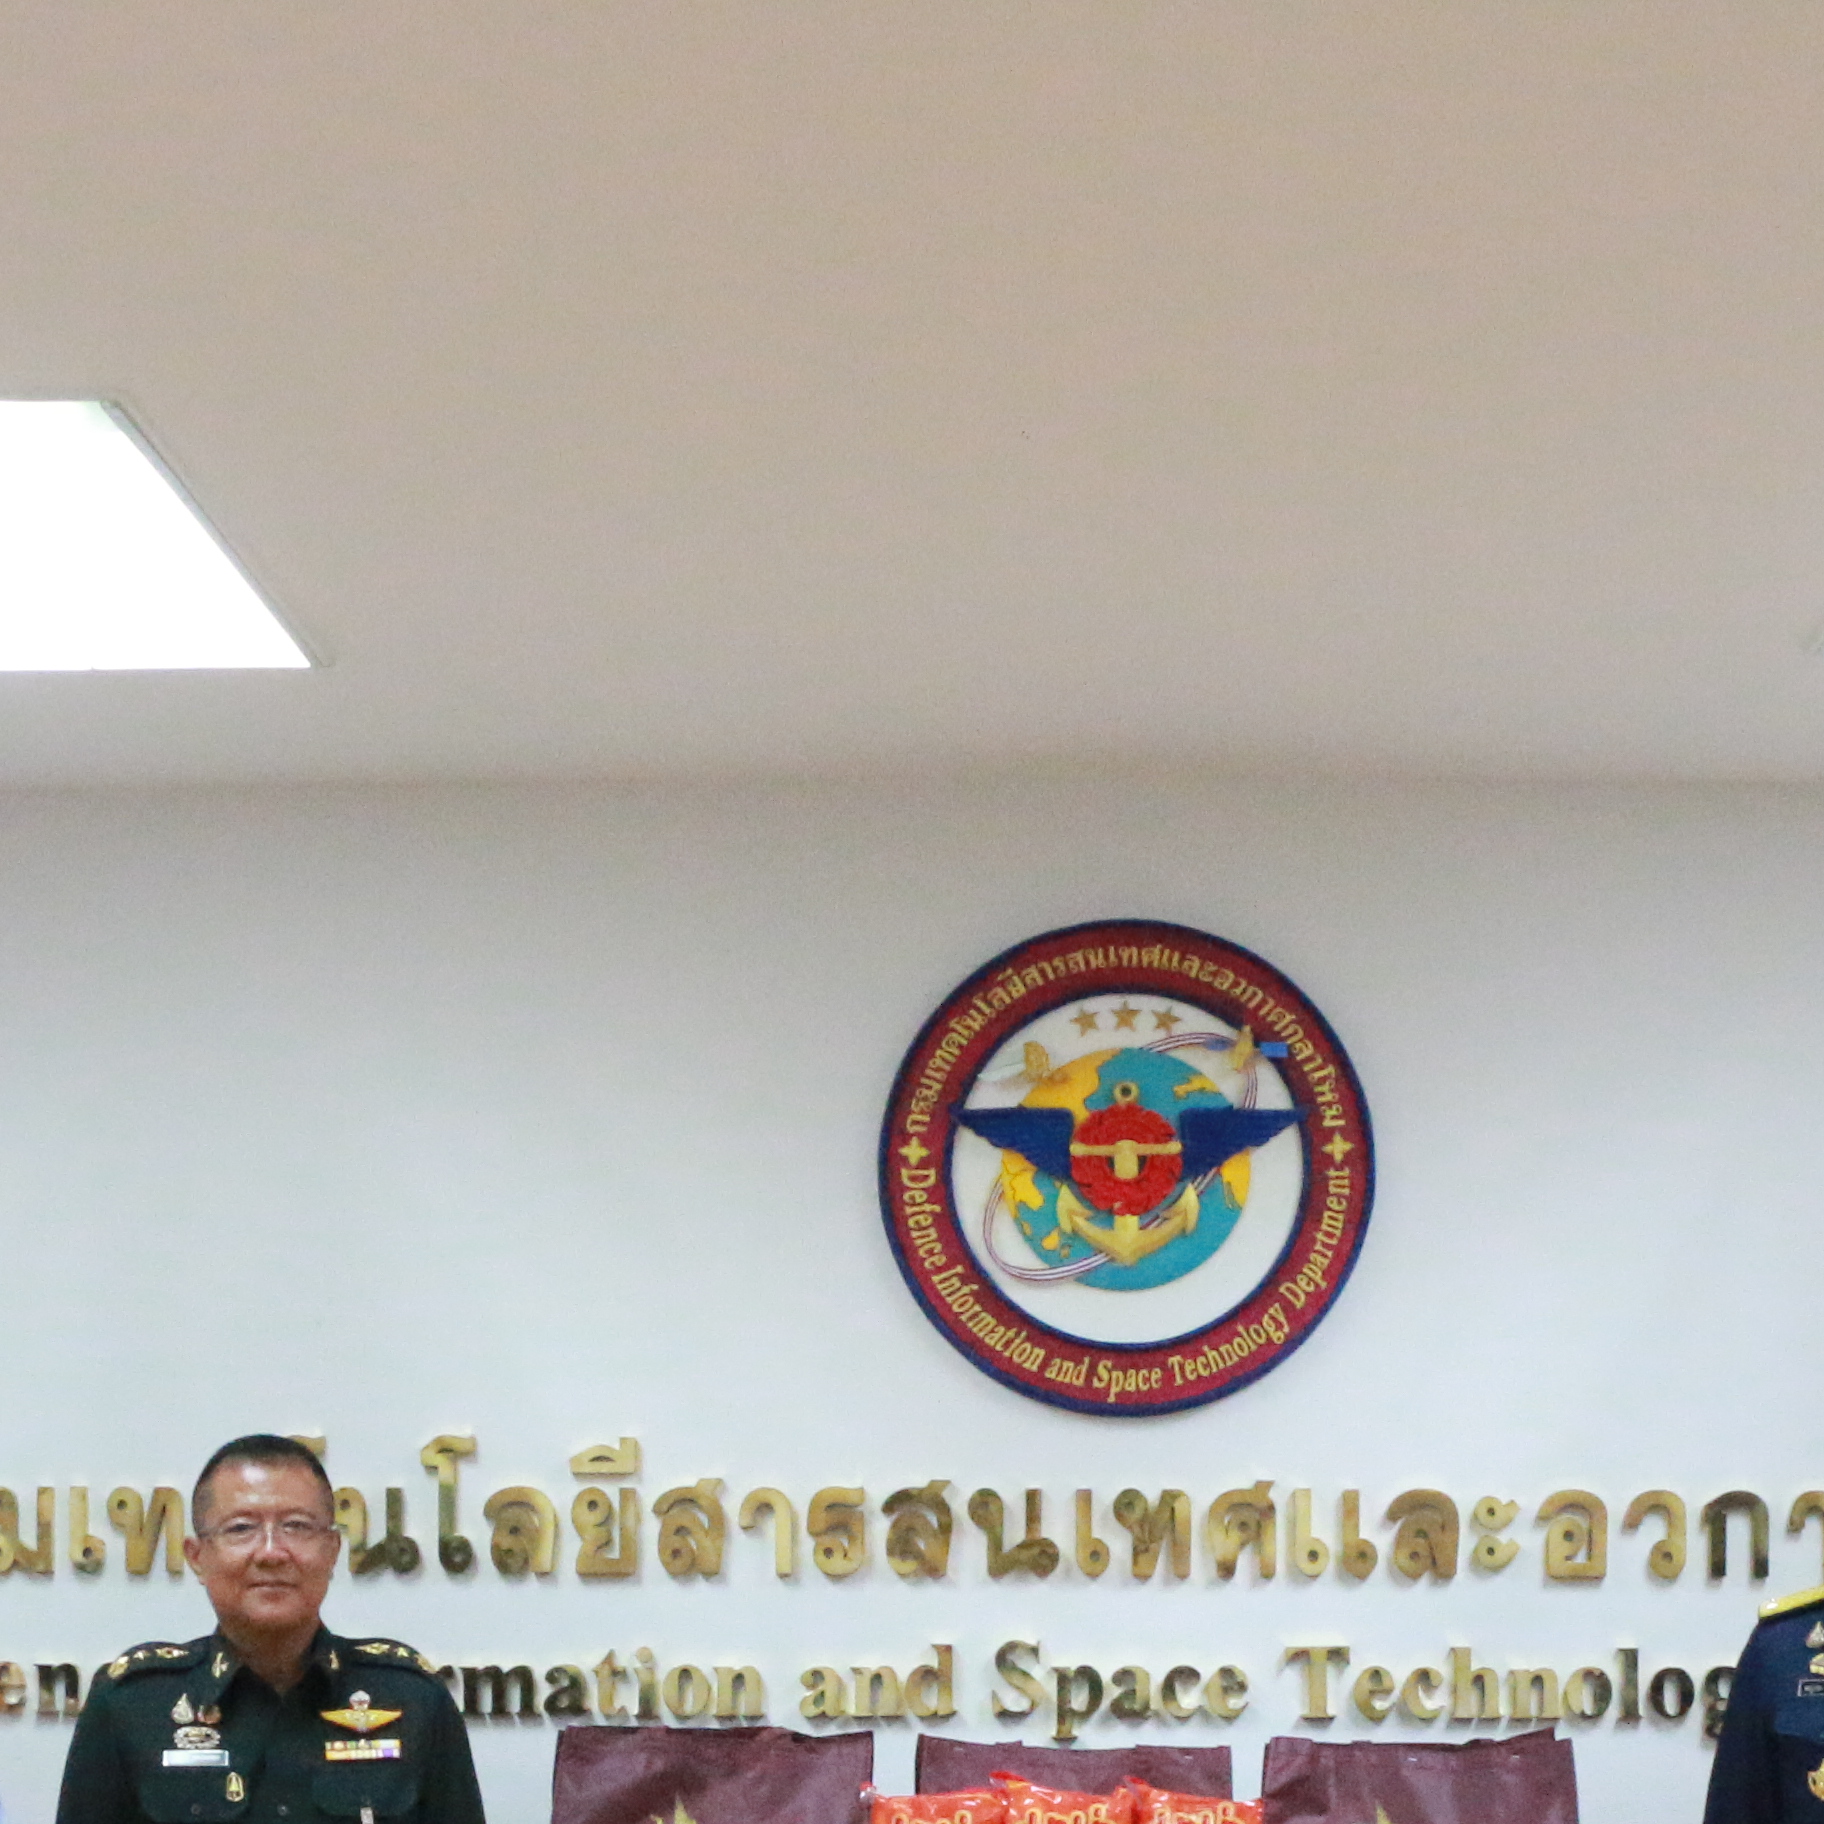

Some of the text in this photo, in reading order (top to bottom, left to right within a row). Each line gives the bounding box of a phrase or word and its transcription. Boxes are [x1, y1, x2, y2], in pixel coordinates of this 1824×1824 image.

[900, 1165, 1351, 1403] Defence Information and Space Technology Department
[799, 1642, 959, 1718] and
[991, 1639, 1249, 1740] Space
[1283, 1644, 1740, 1738] Technolog
